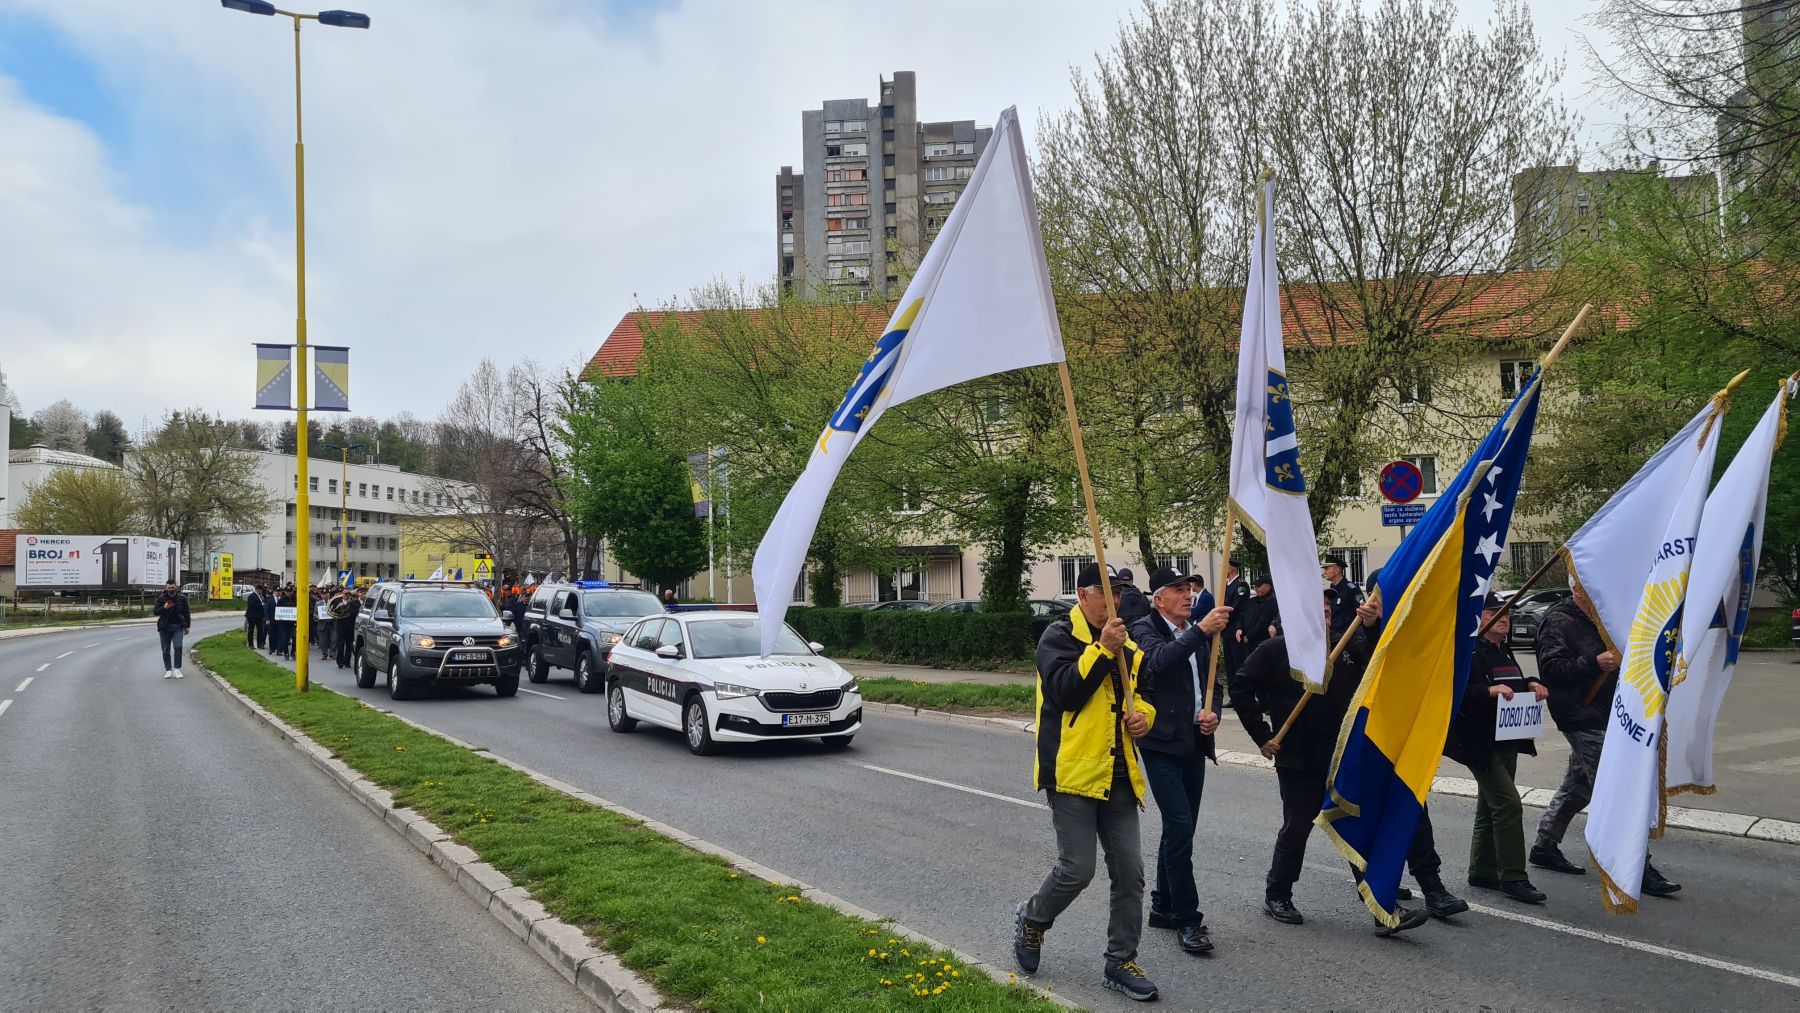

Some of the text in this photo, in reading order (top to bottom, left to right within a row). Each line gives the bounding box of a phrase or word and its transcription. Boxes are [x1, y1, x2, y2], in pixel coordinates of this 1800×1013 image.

[29, 550, 80, 559] BROJ #1
[745, 662, 817, 670] POLICIJA
[647, 677, 676, 698] POLICIJA
[1498, 705, 1542, 728] DOBOJ ISTOK
[1614, 694, 1646, 742] BOSNE
